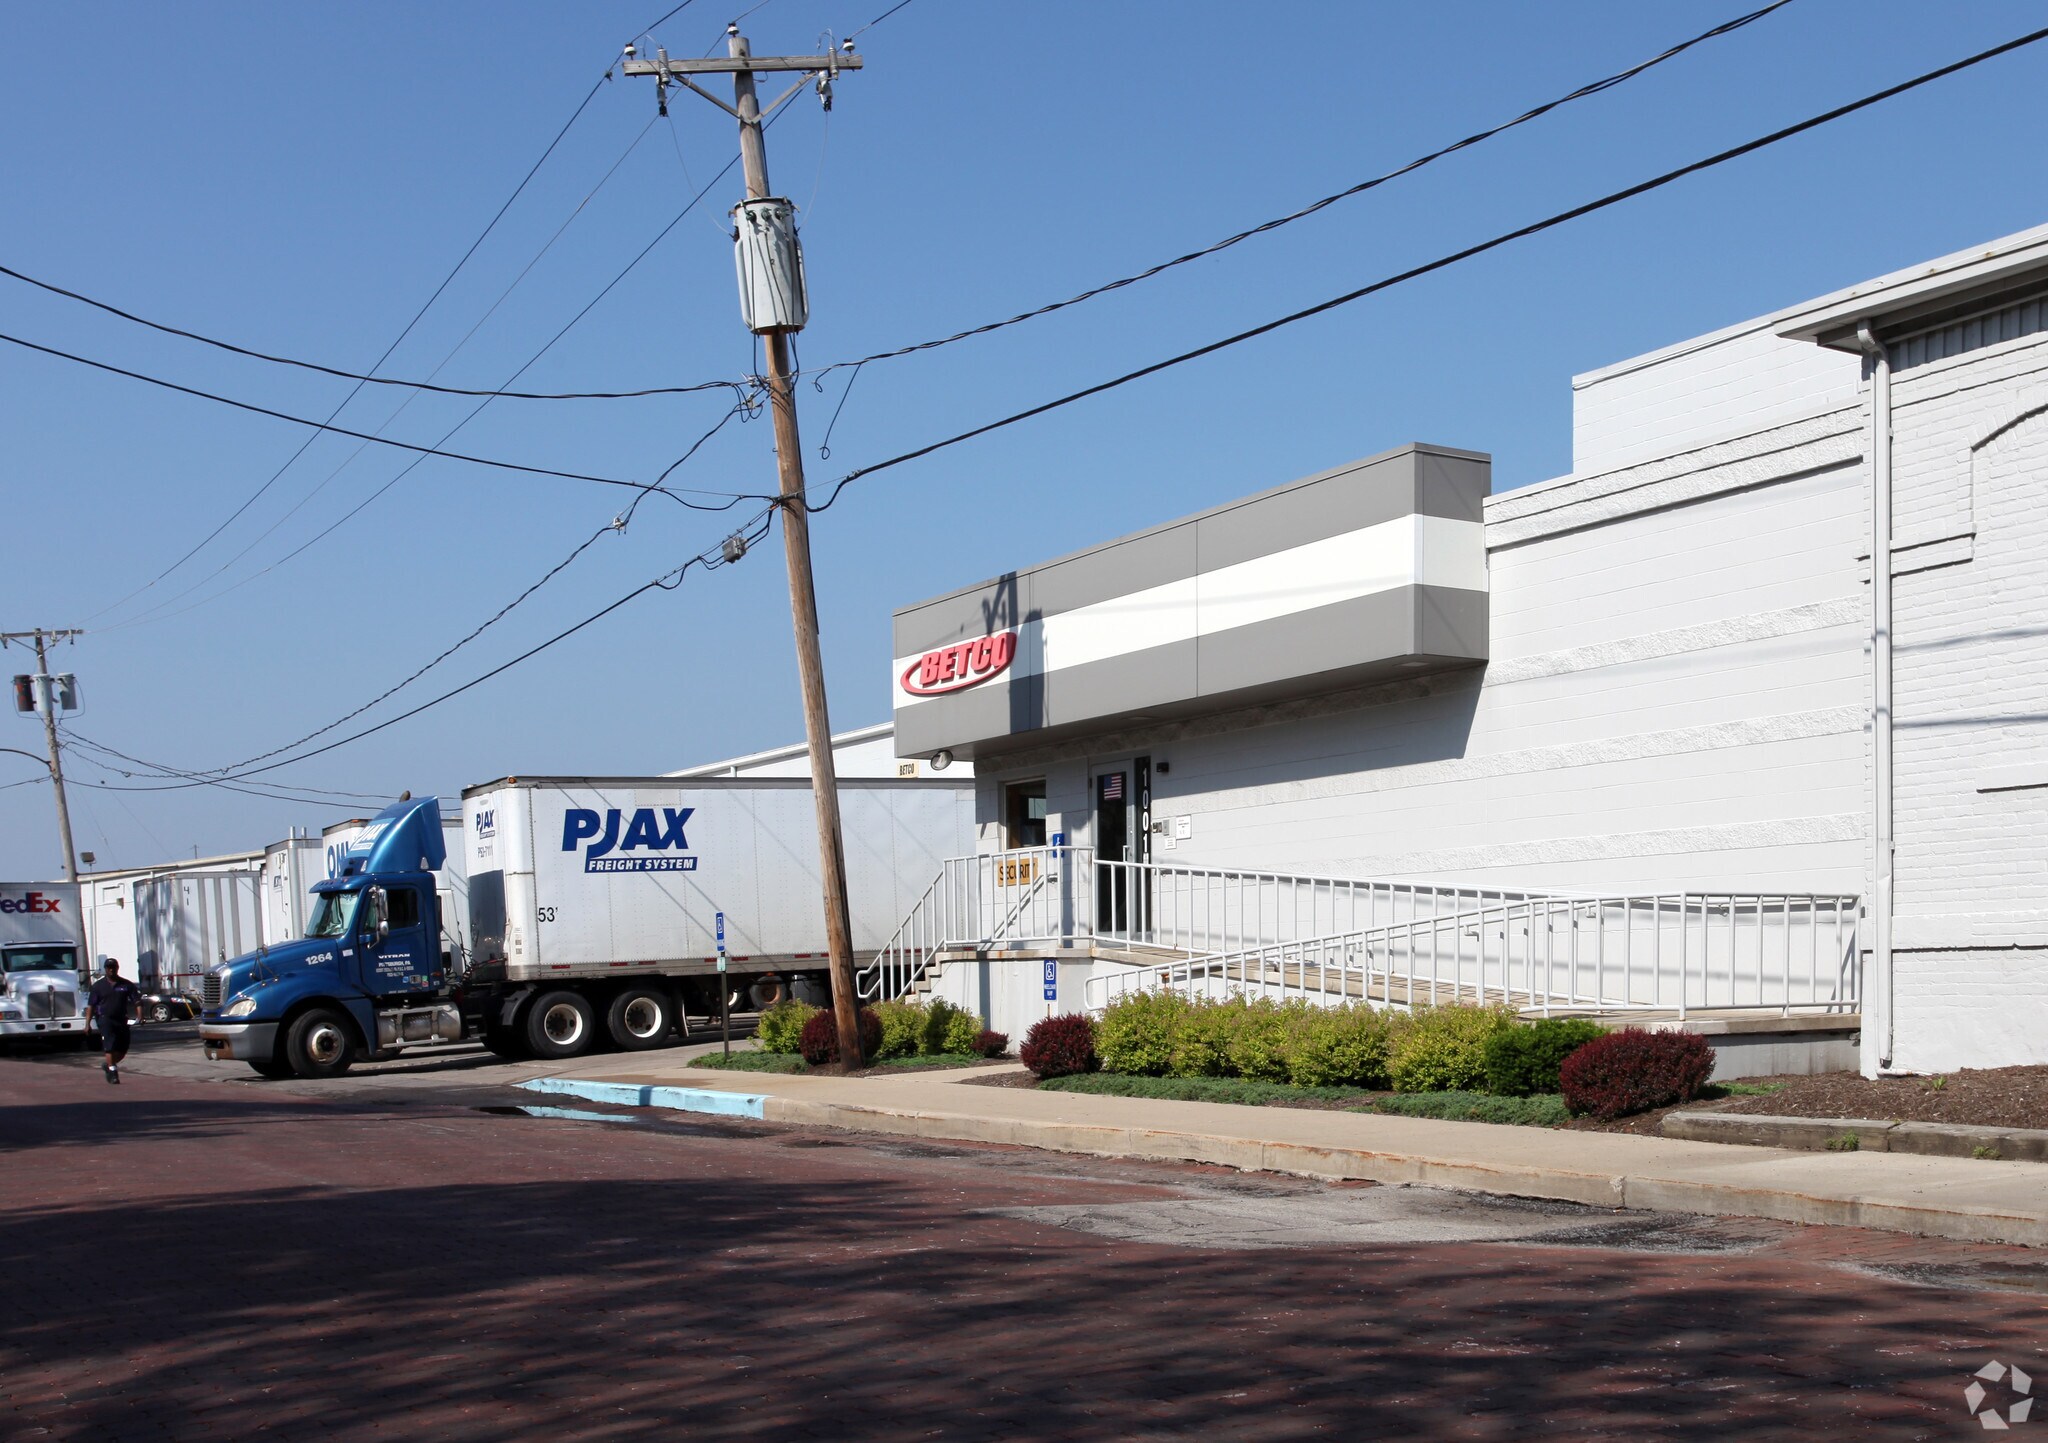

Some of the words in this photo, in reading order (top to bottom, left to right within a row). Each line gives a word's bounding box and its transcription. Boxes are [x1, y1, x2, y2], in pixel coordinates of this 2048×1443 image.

[920, 632, 1017, 686] BETCO
[899, 762, 915, 776] BETCO
[476, 809, 495, 834] PJAX
[561, 808, 696, 860] PJAX
[588, 859, 642, 872] FREIGHT
[644, 858, 694, 870] SYSTEM
[999, 863, 1036, 881] SECRIT
[0, 892, 61, 914] edEx
[305, 951, 333, 966] 1264
